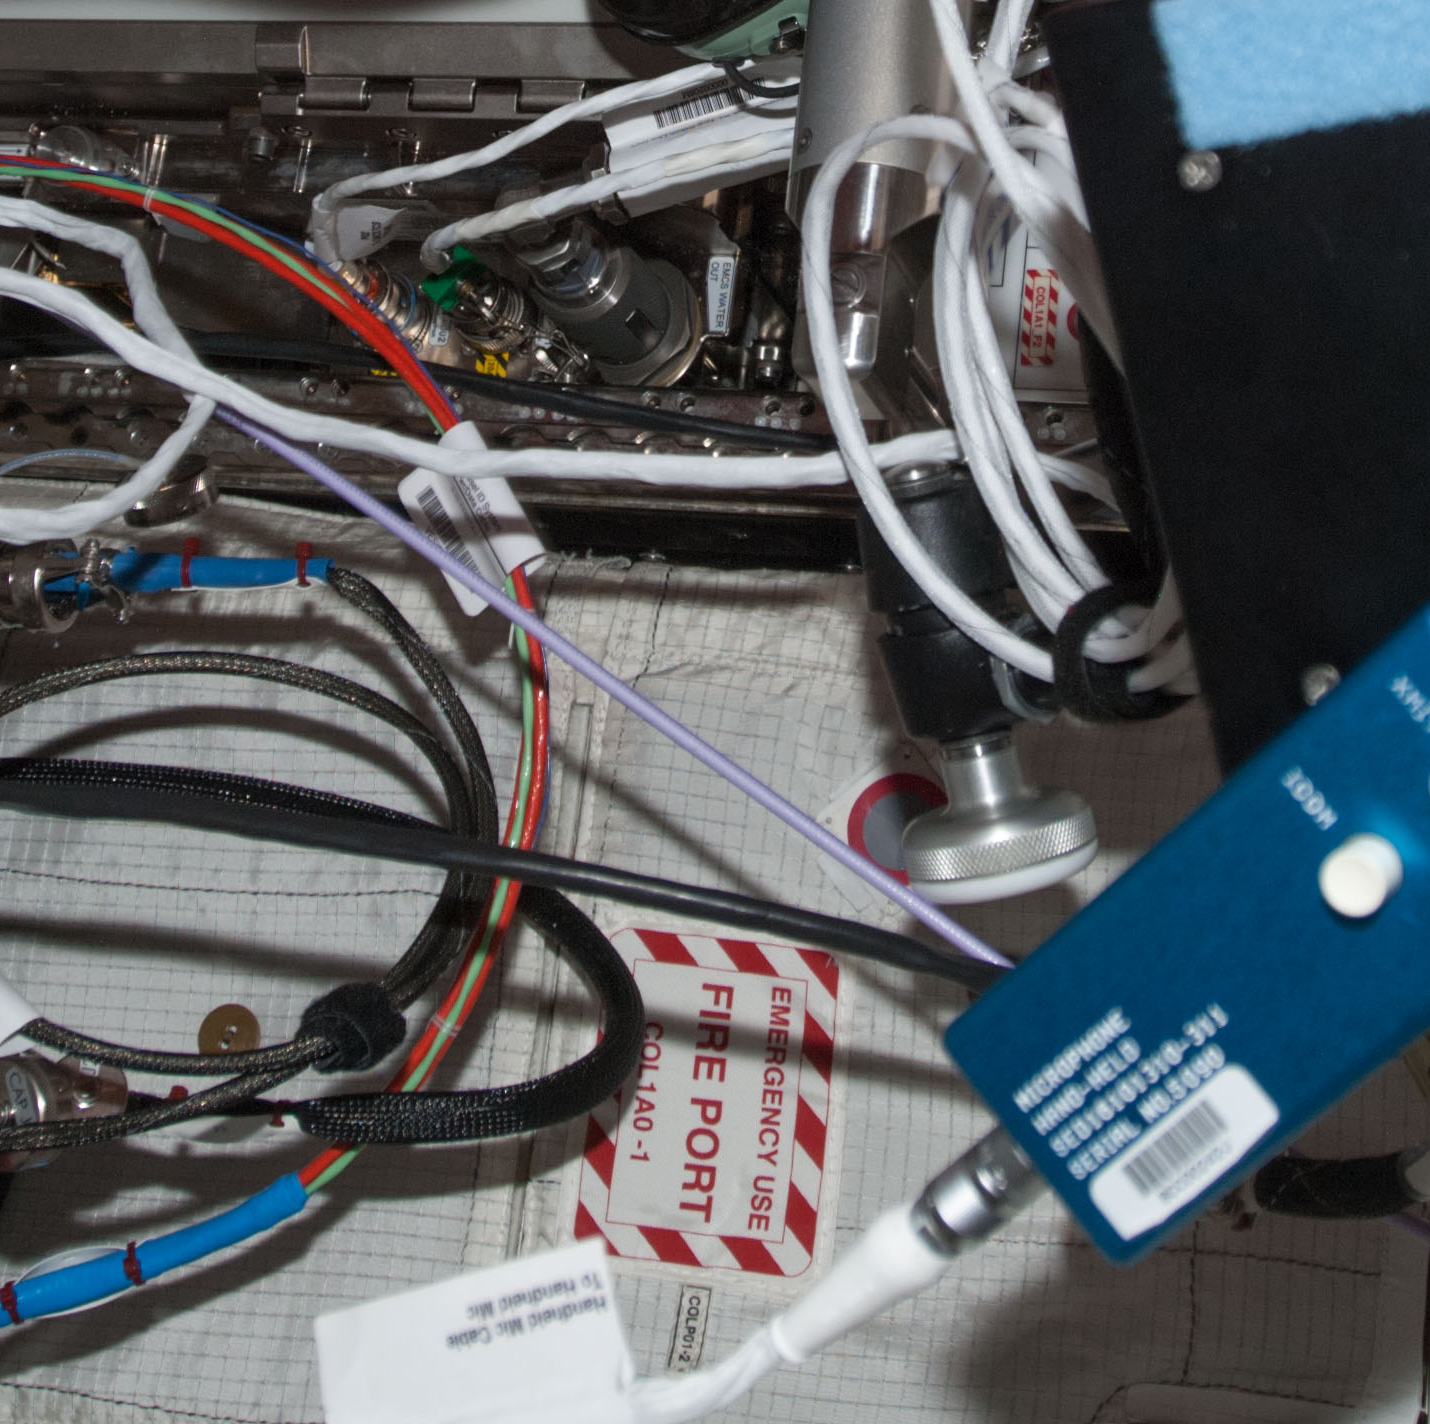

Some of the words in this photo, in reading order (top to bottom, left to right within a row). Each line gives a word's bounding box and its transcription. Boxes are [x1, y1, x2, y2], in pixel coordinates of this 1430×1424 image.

[709, 261, 719, 281] OUT
[720, 261, 731, 289] EMCS
[715, 292, 727, 328] WATER
[474, 491, 486, 503] ID
[693, 983, 732, 1082] FIRE
[631, 1019, 664, 1133] COL1A0
[754, 985, 793, 1167] EMERGENCY
[1011, 1006, 1130, 1112] MICROPHONE
[7, 1070, 28, 1112] CAP
[1030, 1035, 1141, 1134] HAND-HELD
[628, 1137, 652, 1164] -1
[681, 1098, 720, 1222] PORT
[1067, 1113, 1140, 1180] SERIAL
[748, 1174, 774, 1233] USE
[497, 1277, 577, 1315] Handheld
[579, 1270, 604, 1294] To
[464, 1299, 496, 1324] Mic
[492, 1315, 525, 1342] Mic
[527, 1293, 609, 1332] Handheld
[677, 1294, 701, 1363] COLP01-2
[443, 1324, 493, 1355] Cable
